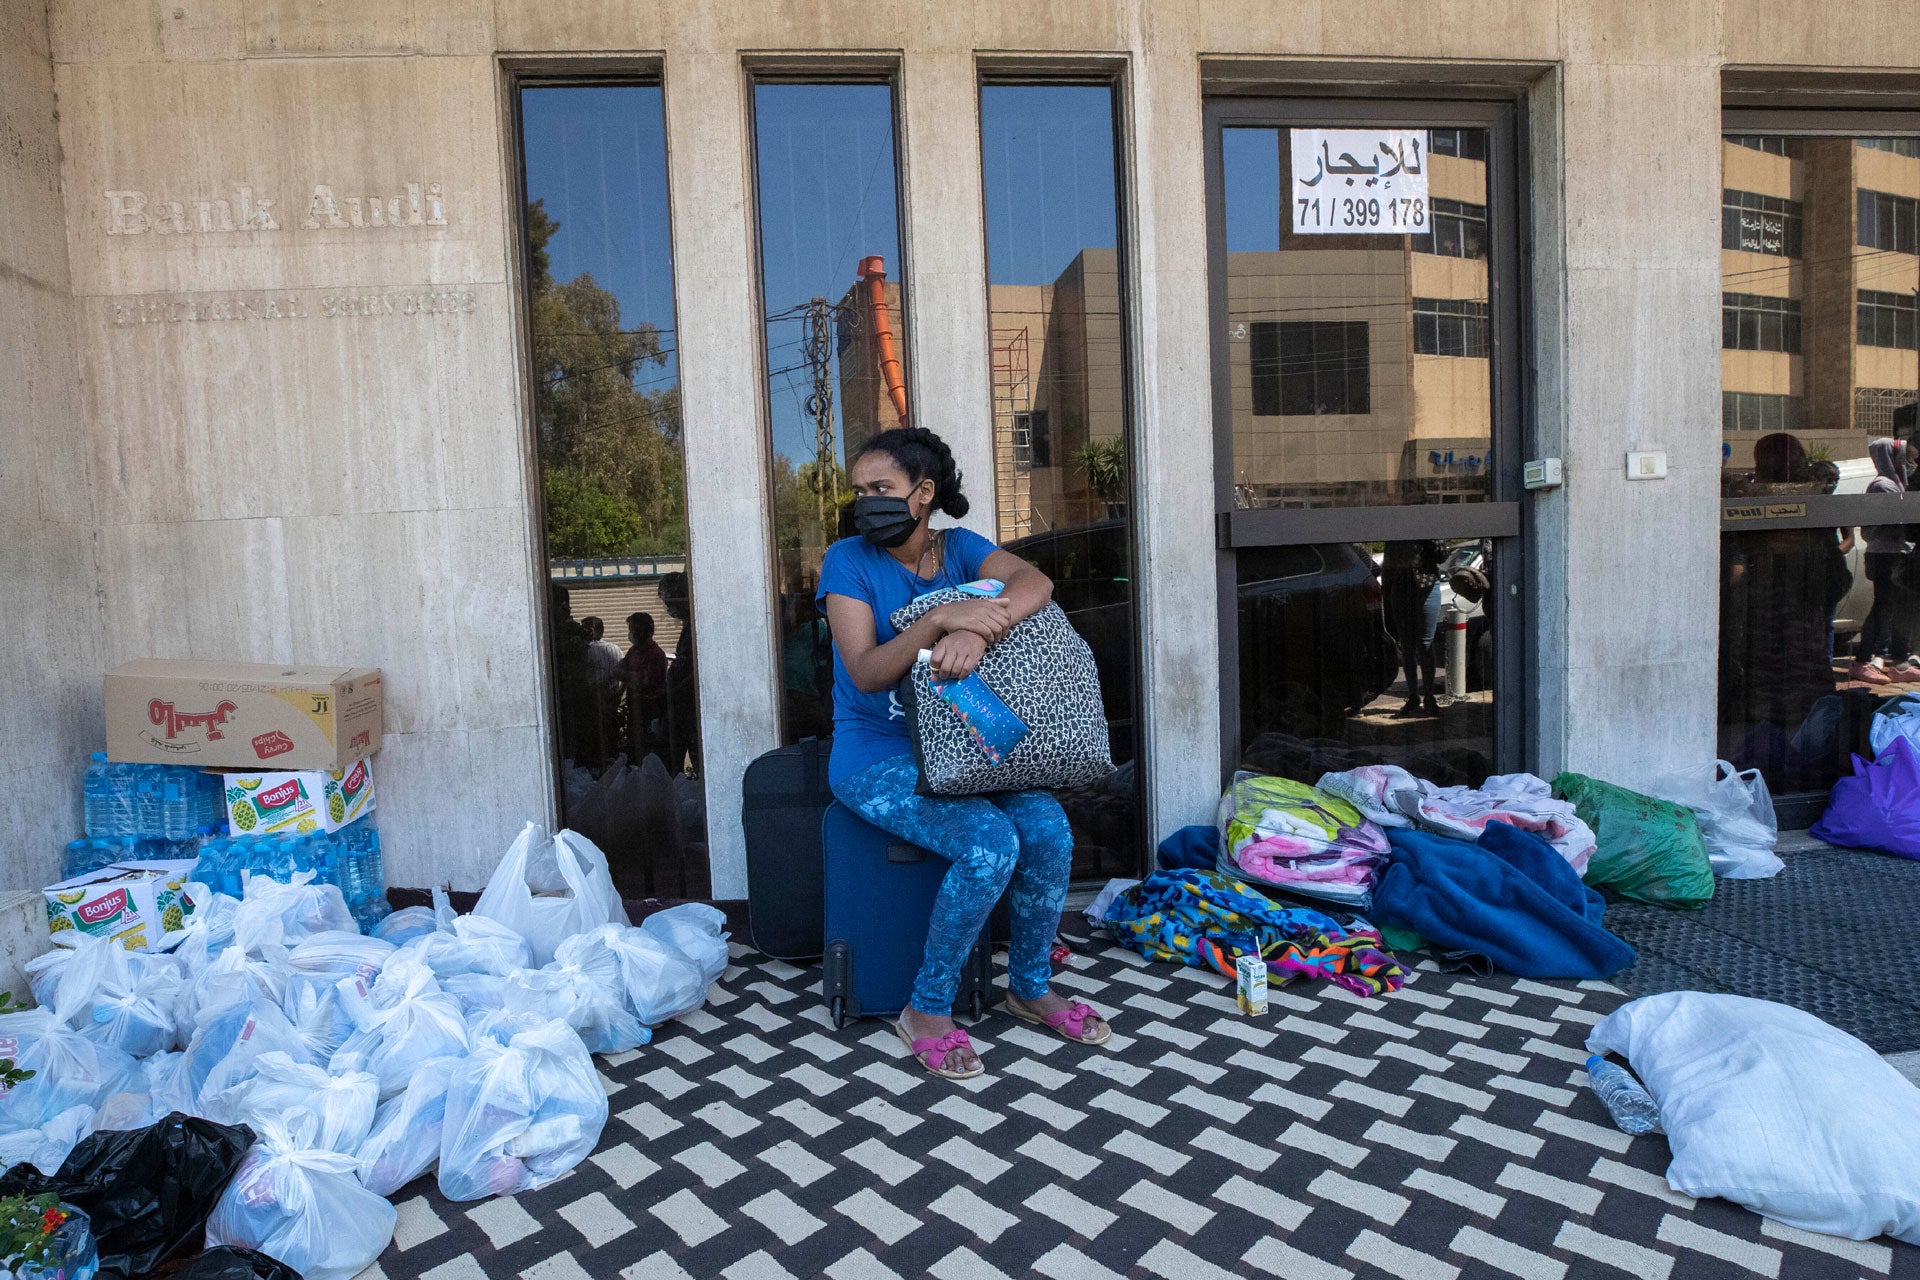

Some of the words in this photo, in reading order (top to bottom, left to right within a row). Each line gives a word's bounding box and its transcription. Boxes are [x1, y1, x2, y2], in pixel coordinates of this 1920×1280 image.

[1298, 138, 1421, 190] للإيجار
[103, 185, 281, 236] Bank
[301, 181, 449, 230] Audi
[1298, 197, 1321, 227] 71
[1329, 197, 1337, 227] /
[1343, 198, 1380, 226] 399
[1388, 198, 1424, 226] 178
[114, 296, 309, 325] EXTERNAL
[320, 291, 476, 318] SERVICES
[1726, 507, 1762, 518] Pull
[147, 698, 238, 741] ماستر
[254, 735, 277, 747] Chips
[264, 742, 288, 755] Curvy
[262, 786, 295, 804] Bonjus
[84, 895, 122, 917] Bonjus
